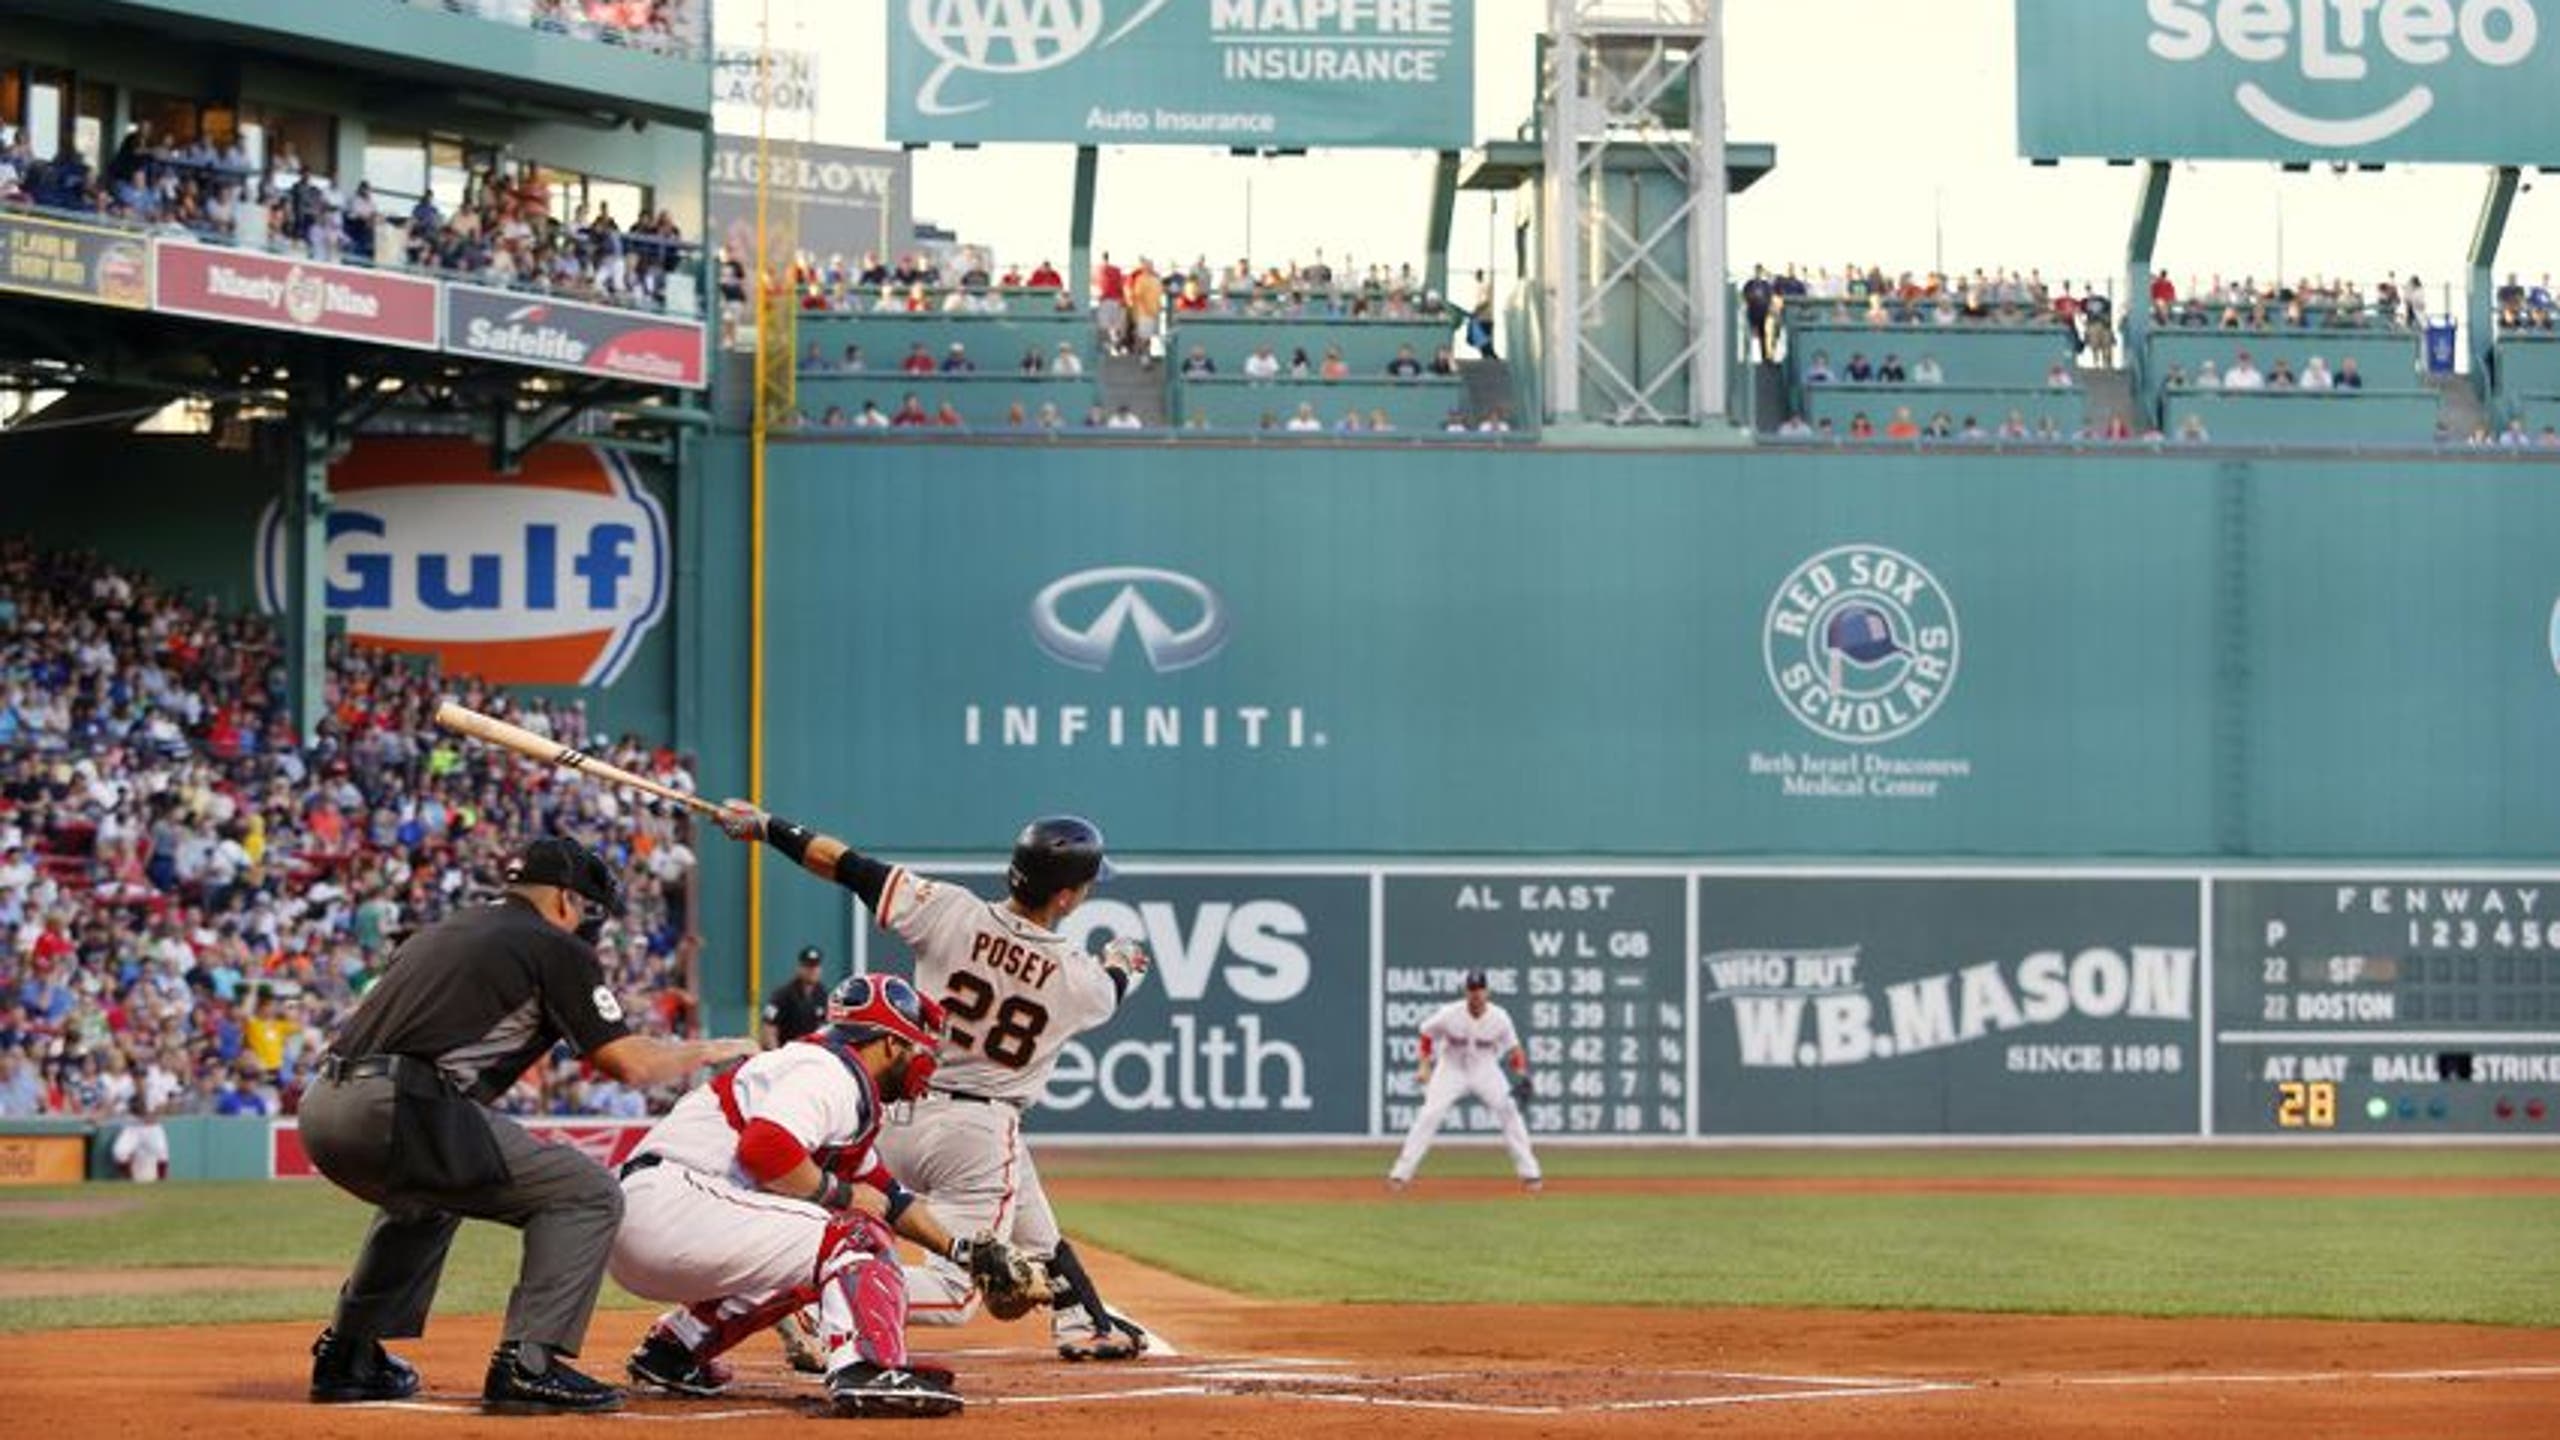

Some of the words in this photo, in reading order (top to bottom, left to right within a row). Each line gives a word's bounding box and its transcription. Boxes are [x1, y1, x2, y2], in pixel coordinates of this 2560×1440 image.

[1210, 0, 1454, 33] MAPFRE
[1224, 48, 1438, 82] INSURANCE
[1086, 107, 1150, 132] Auto
[1156, 108, 1275, 133] Insurance
[207, 264, 285, 309] Ninety
[326, 282, 380, 317] Nine
[467, 317, 587, 364] Safelite
[326, 510, 636, 613] Gulf
[1775, 563, 1837, 636] RED
[1850, 553, 1925, 605] SOX
[1781, 625, 1949, 732] SCHOLARS
[1750, 752, 1797, 775] Beth
[1803, 752, 1858, 775] Israel
[1864, 753, 1971, 776] Deaconess
[1782, 774, 1864, 797] Medical
[1869, 776, 1939, 798] Center
[1456, 884, 1502, 911] AL
[1519, 885, 1615, 911] EAST
[2336, 887, 2540, 914] FENWAY
[1527, 931, 1565, 958] W
[1576, 931, 1597, 957] L
[2266, 919, 2287, 947] P
[2408, 920, 2419, 947] 1
[2432, 920, 2449, 948] 2
[2459, 920, 2478, 949] 3
[2494, 920, 2514, 949] 4
[2521, 920, 2541, 949] 5
[970, 931, 1057, 990] POSEY
[1709, 955, 1782, 988] WHO
[1793, 955, 1858, 987] BUT
[2328, 956, 2365, 984] SF
[1386, 966, 1519, 994] BALTIMRE
[1528, 966, 1564, 995] 53
[939, 969, 1049, 1069] 28
[1532, 1001, 1564, 1029] 51
[1624, 1002, 1635, 1029] 1
[2296, 993, 2395, 1021] BOSTON
[1039, 1013, 1313, 1111] ealth
[1528, 1035, 1564, 1063] 52
[1569, 1036, 1605, 1063] 42
[1619, 1036, 1639, 1062] 2
[2006, 1044, 2103, 1072] SINCE
[2111, 1044, 2183, 1073] 1898
[2263, 1055, 2298, 1081] AT
[2302, 1055, 2348, 1081] BAT
[2371, 1055, 2440, 1082] BALL
[1620, 1070, 1638, 1097] 7
[2277, 1081, 2337, 1128] 28
